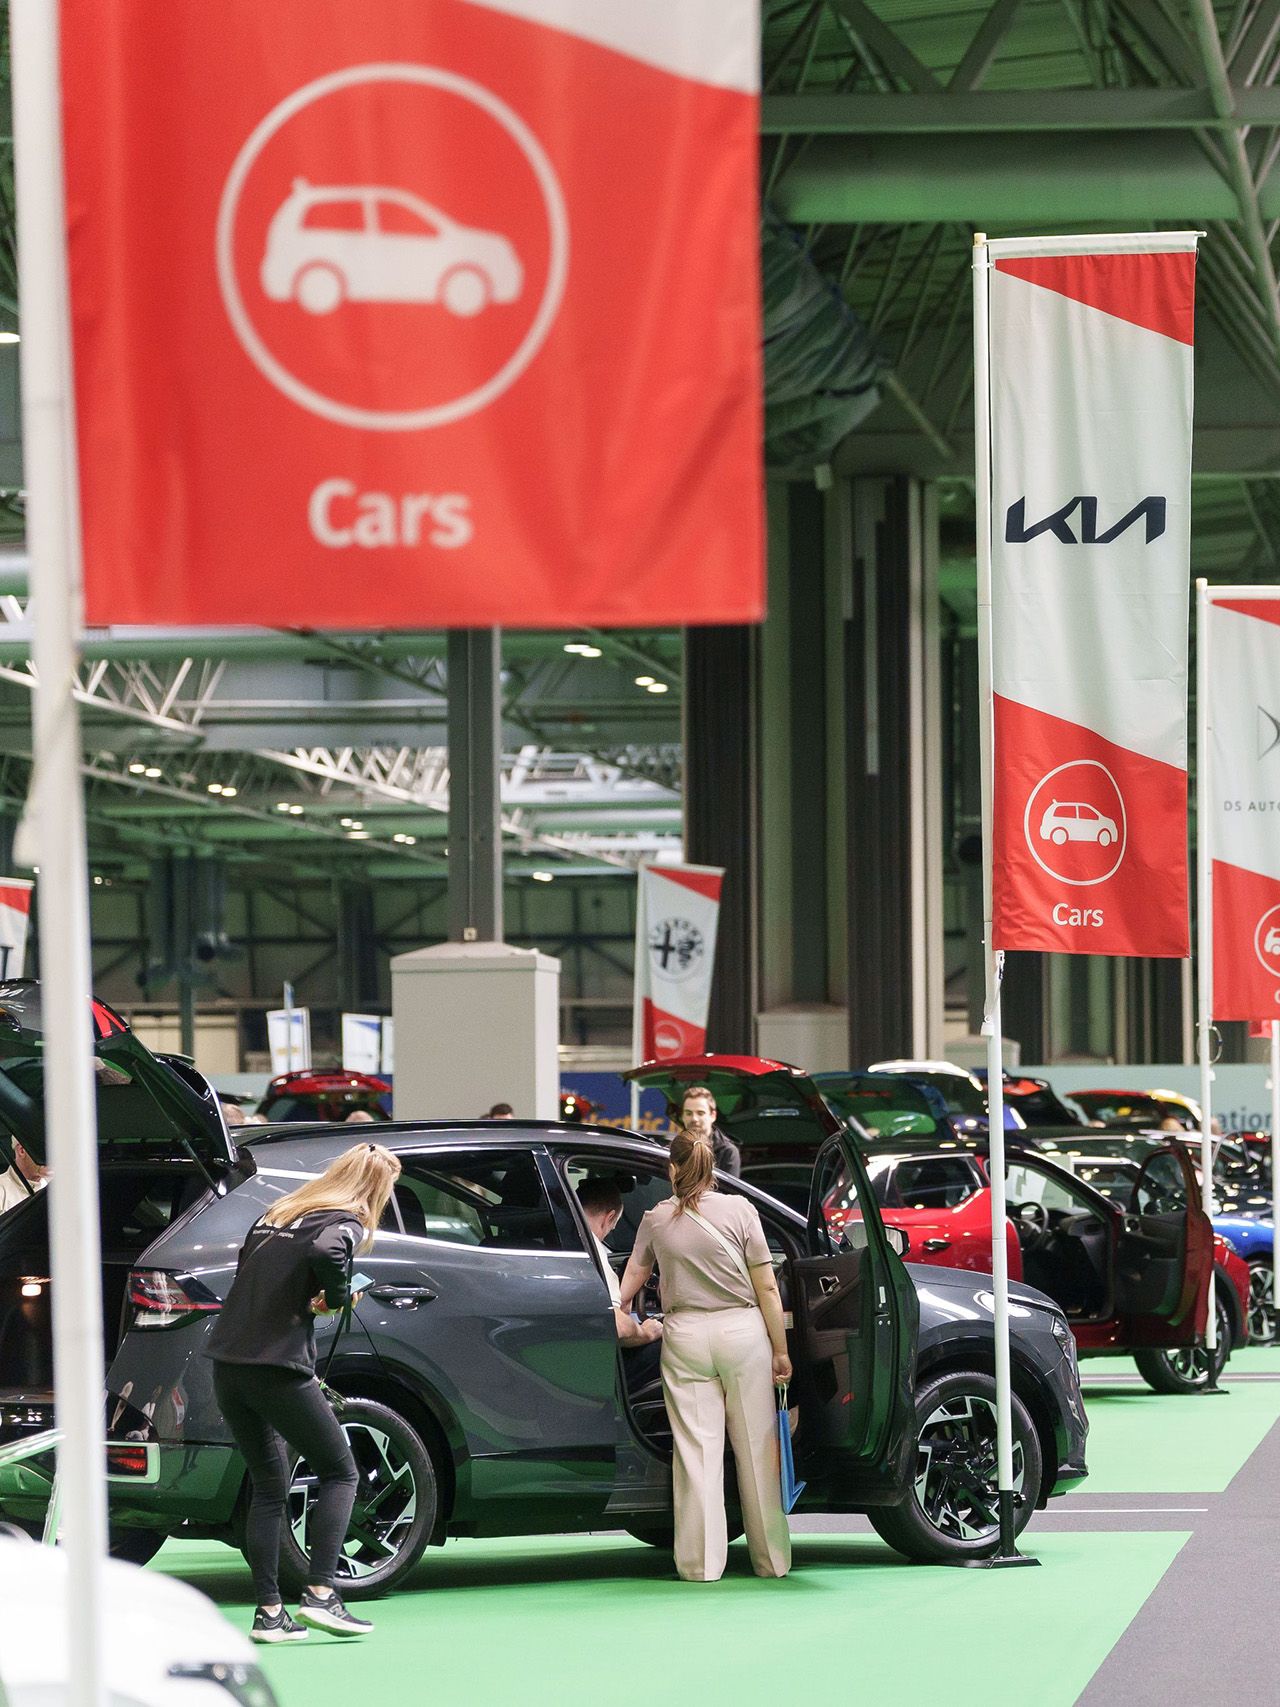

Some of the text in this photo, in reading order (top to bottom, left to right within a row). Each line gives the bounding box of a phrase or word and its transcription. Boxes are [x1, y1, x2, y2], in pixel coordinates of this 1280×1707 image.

[308, 479, 474, 550] Cars
[1005, 495, 1167, 545] KIA
[1223, 800, 1242, 812] DS
[1052, 902, 1105, 929] Cars
